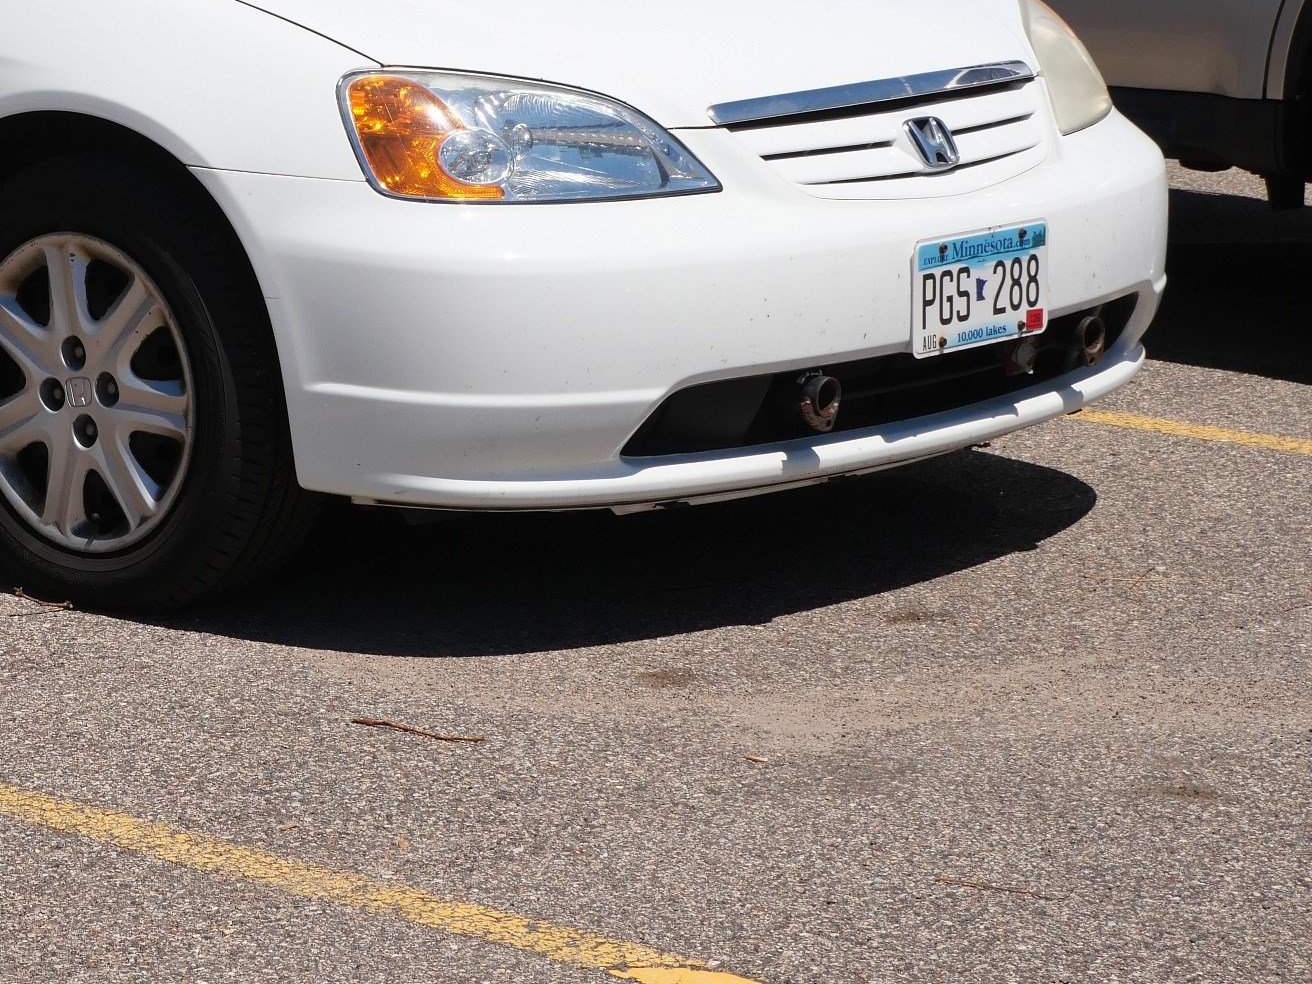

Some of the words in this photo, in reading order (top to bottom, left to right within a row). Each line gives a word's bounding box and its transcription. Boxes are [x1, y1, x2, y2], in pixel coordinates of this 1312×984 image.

[922, 266, 971, 330] PGS
[992, 253, 1040, 316] 288
[922, 334, 937, 352] AUG
[957, 328, 983, 343] 10,000
[985, 324, 1007, 336] lakes
